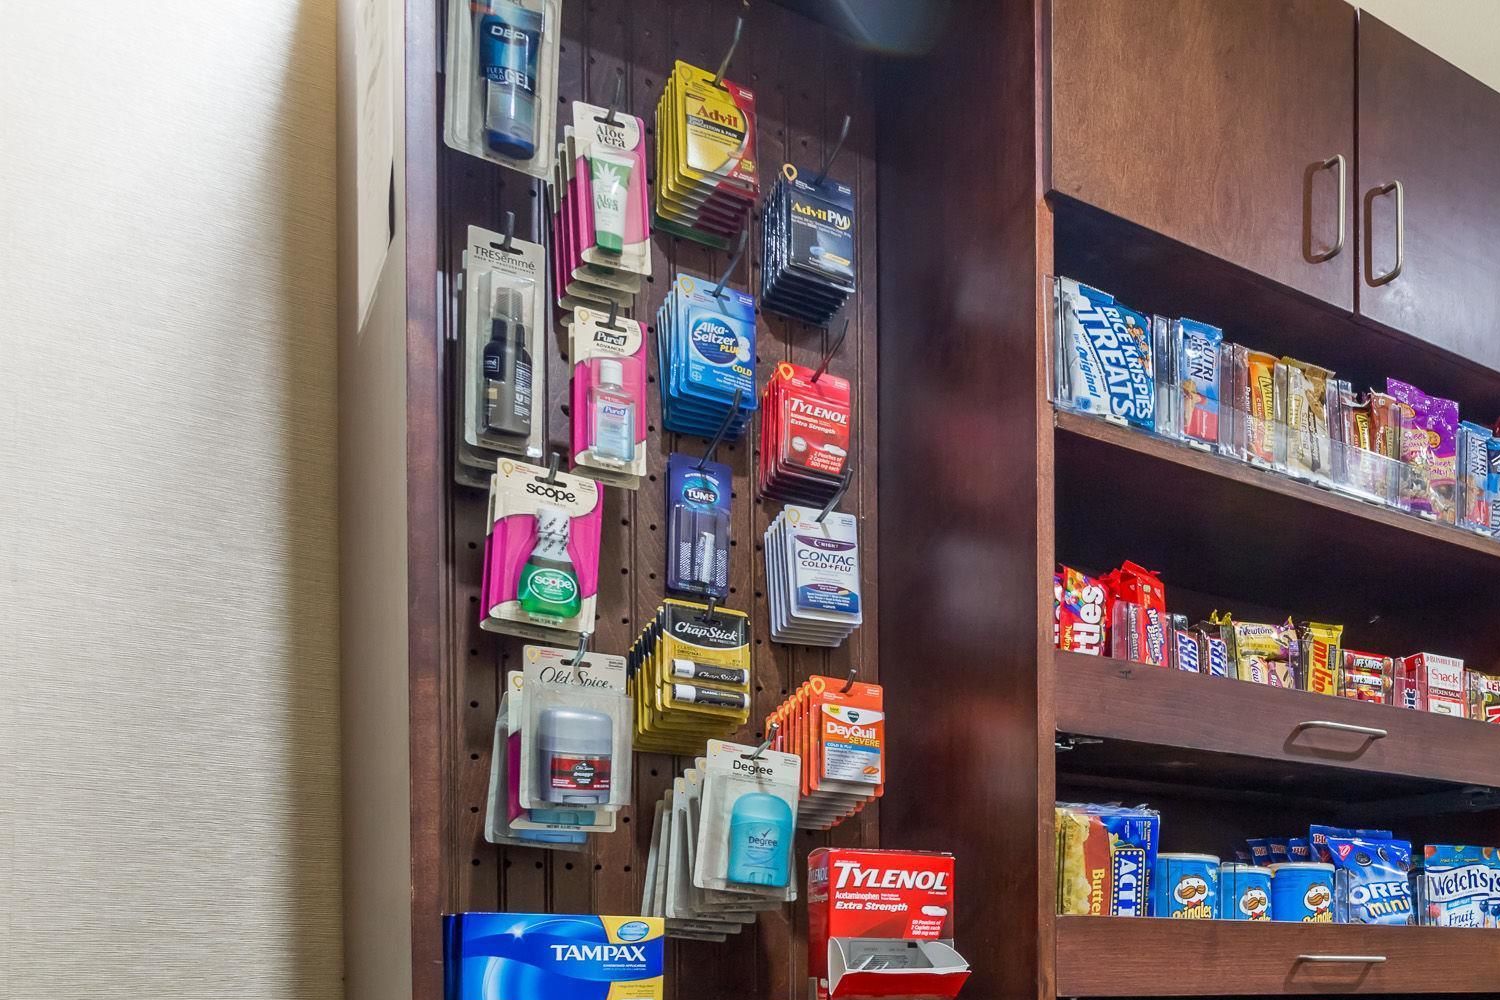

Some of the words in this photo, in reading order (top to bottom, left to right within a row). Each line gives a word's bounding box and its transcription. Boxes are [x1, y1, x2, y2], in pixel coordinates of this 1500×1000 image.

[697, 105, 738, 128] Advil
[595, 125, 626, 140] Aloe
[793, 202, 827, 221] Advil
[827, 209, 847, 227] PM
[473, 244, 536, 271] TRESemmé
[596, 330, 627, 346] Purell
[692, 329, 737, 347] Seltzer
[696, 321, 728, 336] Alka-
[1078, 305, 1136, 417] TREATS
[1103, 306, 1132, 344] RICE
[1121, 341, 1151, 420] KRISPIES
[1201, 337, 1214, 383] NUTRI
[731, 364, 753, 377] COLD
[1075, 345, 1102, 399] Original
[604, 405, 626, 417] Purell
[790, 397, 848, 425] TYLENOL
[790, 418, 808, 430] Extra
[808, 424, 836, 436] Strength
[1478, 438, 1488, 477] NUTRI
[526, 482, 577, 503] scope
[687, 489, 715, 502] TUMS
[1490, 499, 1500, 538] NUTRI
[797, 549, 855, 567] CONTAC
[534, 574, 574, 592] scope
[675, 621, 738, 642] ChapStick
[1240, 626, 1274, 636] Newtons
[539, 666, 571, 684] Old
[571, 670, 608, 689] Spice
[1431, 668, 1459, 684] Snack
[826, 721, 876, 740] DayQuil
[848, 736, 881, 748] SEVERE
[733, 760, 773, 776] Degree
[748, 836, 778, 848] Degree
[833, 861, 949, 891] TYLENOL
[1119, 857, 1138, 903] ACT
[1430, 868, 1489, 897] Welch's
[1091, 867, 1106, 916] Butte
[834, 902, 863, 910] Extra
[864, 901, 908, 912] Strength
[1368, 896, 1410, 917] mini
[1448, 909, 1475, 926] Fruit
[550, 945, 647, 962] TAMPAX
